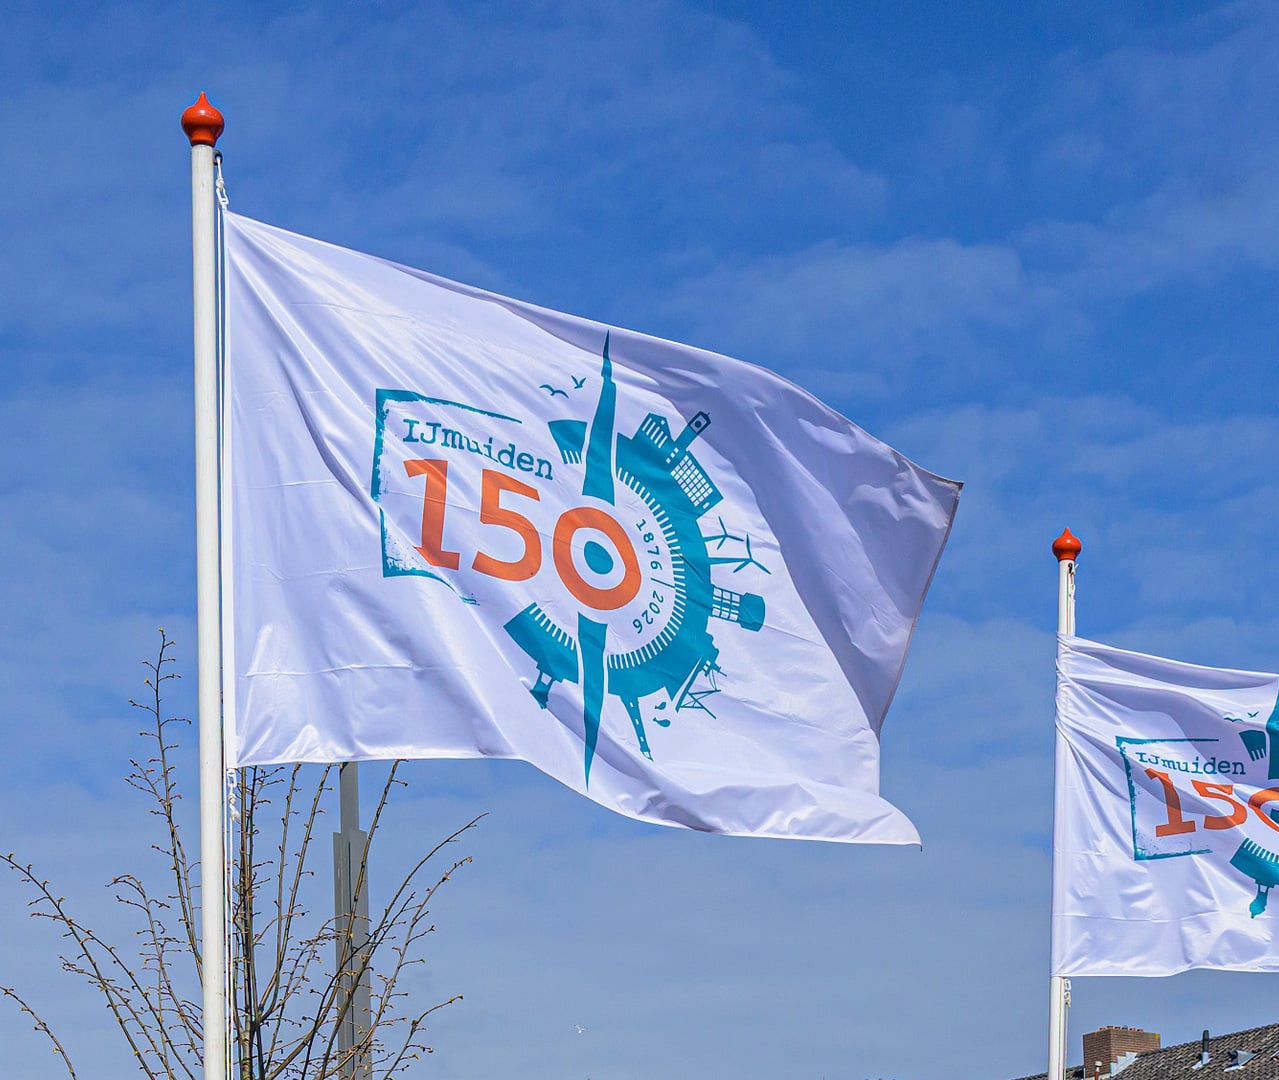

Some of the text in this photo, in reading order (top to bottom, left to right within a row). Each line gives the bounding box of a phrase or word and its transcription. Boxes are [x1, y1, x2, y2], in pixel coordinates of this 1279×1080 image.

[402, 418, 554, 481] IJmuiden
[403, 458, 642, 611] 150
[1135, 751, 1246, 775] IJmuiden
